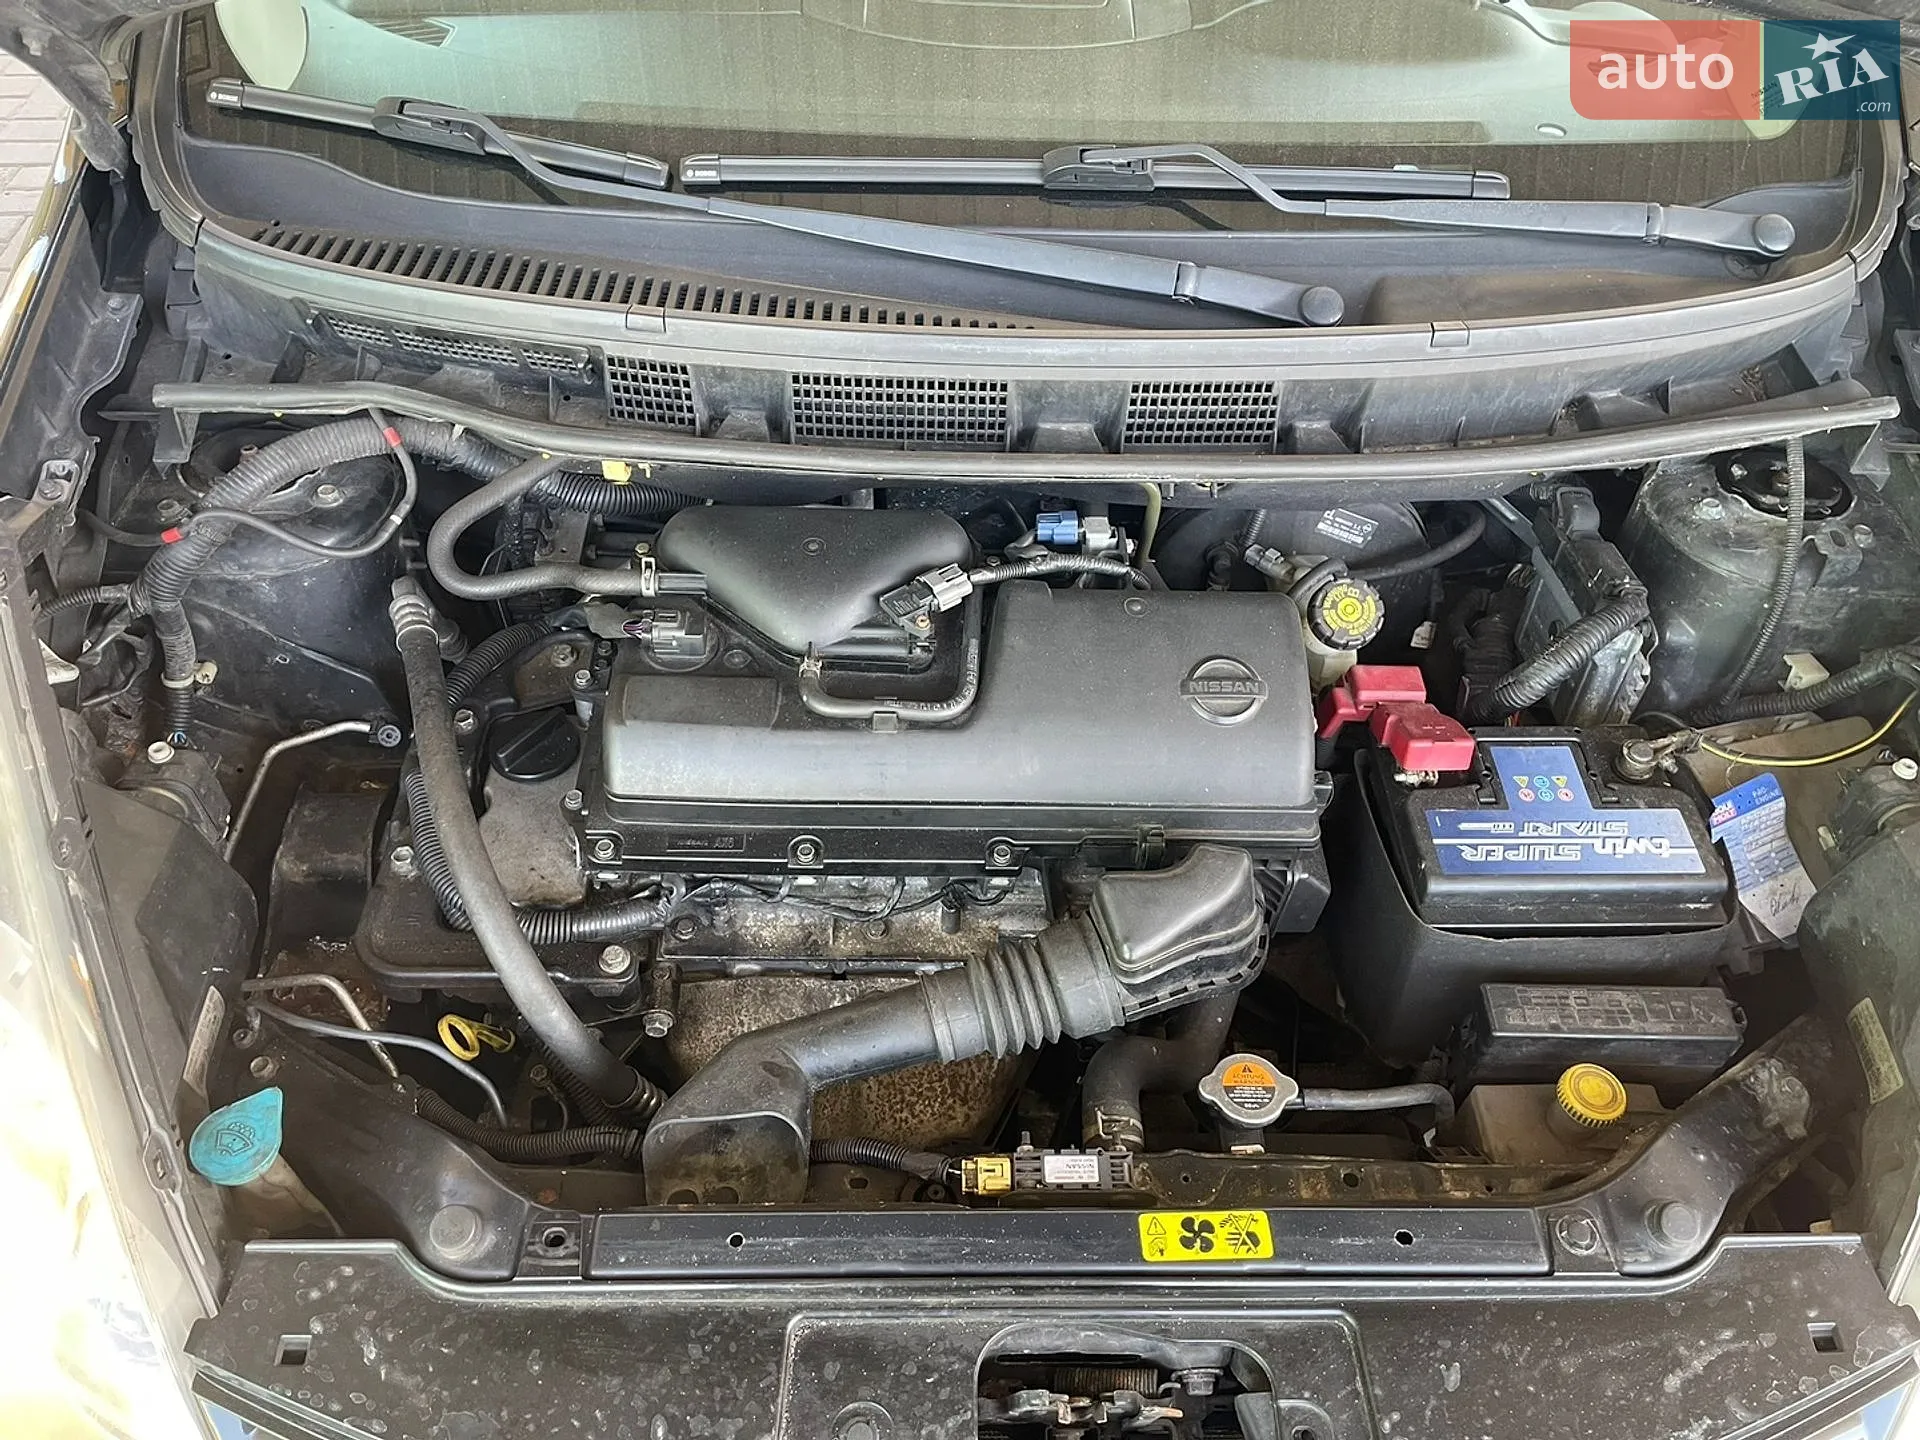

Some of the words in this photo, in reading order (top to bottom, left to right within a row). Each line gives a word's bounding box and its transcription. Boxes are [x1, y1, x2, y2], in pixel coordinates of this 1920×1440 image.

[1189, 681, 1259, 693] NISSAN
[1519, 821, 1630, 838] START
[1457, 844, 1583, 862] SUPER
